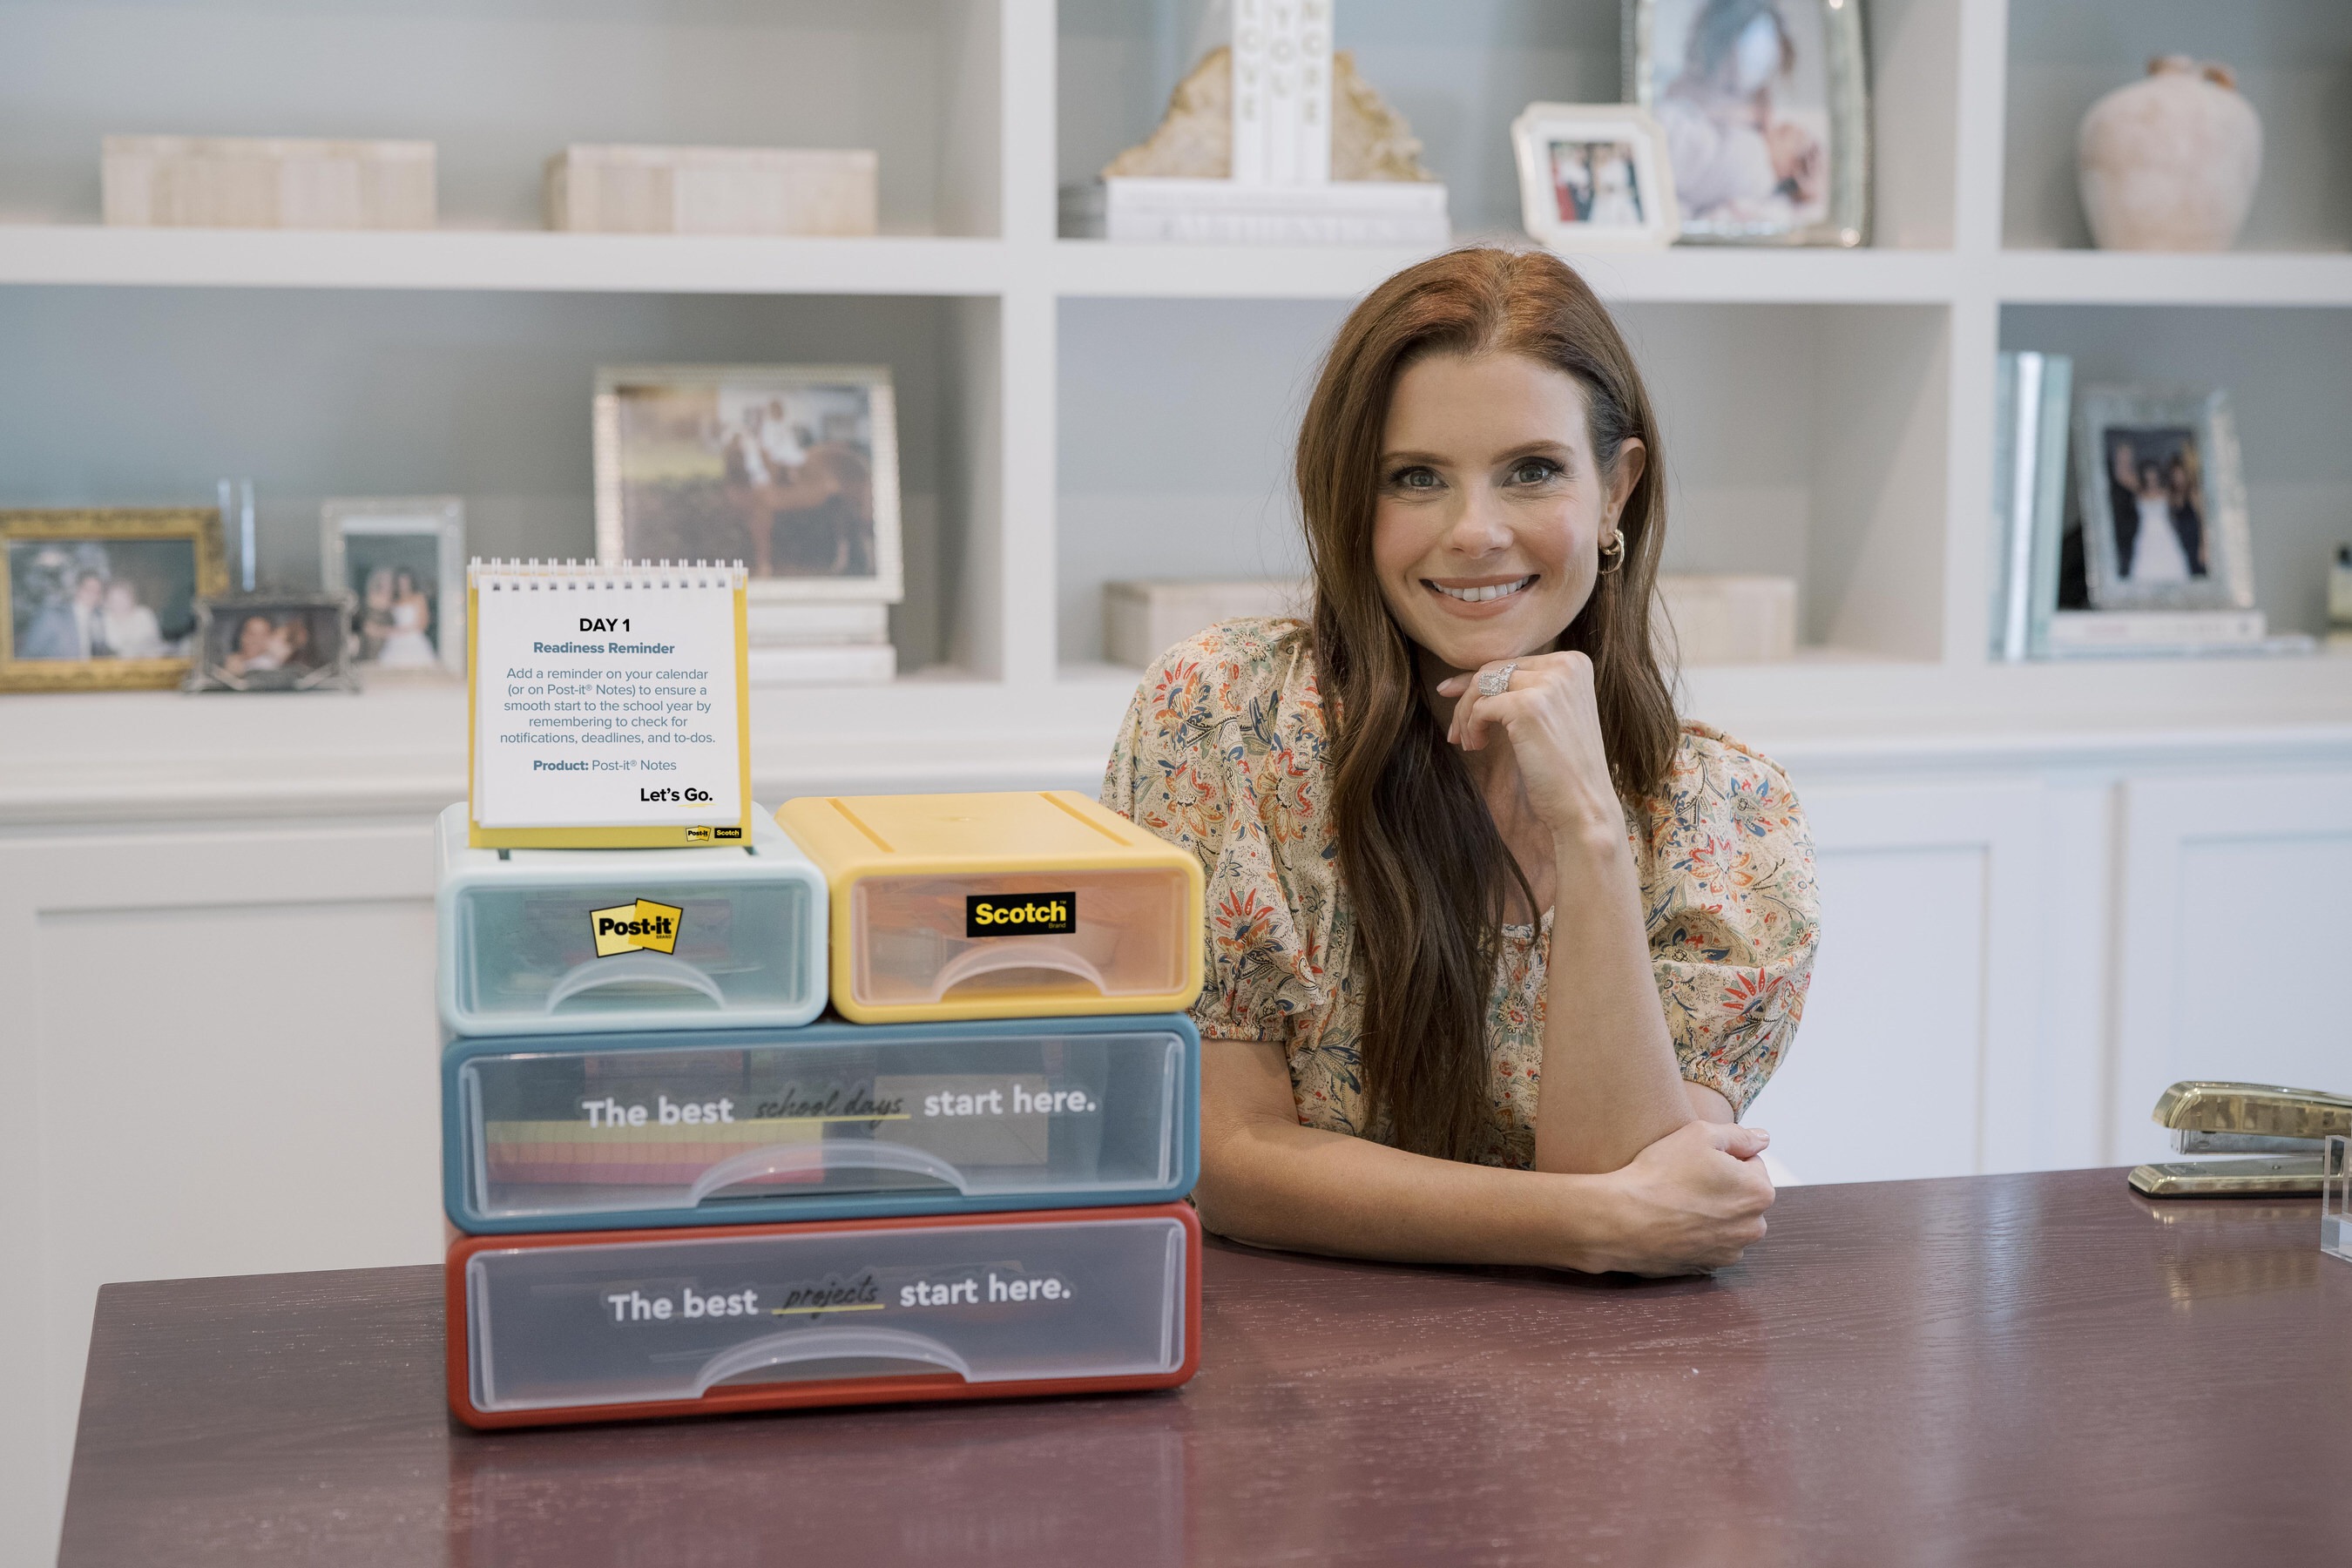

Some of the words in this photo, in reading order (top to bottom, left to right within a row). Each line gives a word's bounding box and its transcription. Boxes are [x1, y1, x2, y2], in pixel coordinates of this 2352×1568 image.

[579, 618, 618, 632] DAY
[622, 618, 630, 632] 1
[533, 641, 605, 654] Readiness
[608, 641, 676, 655] Reminder
[506, 667, 533, 679] Add
[536, 670, 544, 679] a
[547, 667, 604, 679] reminder
[605, 670, 622, 679] on
[625, 670, 653, 683] your
[655, 668, 709, 680] calendar
[508, 683, 525, 698] (or
[527, 686, 544, 695] on
[596, 684, 636, 698] Notes)
[638, 685, 652, 696] to
[654, 686, 697, 696] ensure
[700, 686, 707, 696] a
[504, 700, 551, 712] smooth
[554, 700, 582, 712] start
[584, 700, 597, 712] to
[599, 700, 620, 712] the
[622, 700, 664, 712] school
[666, 702, 694, 714] year
[696, 700, 712, 714] by
[529, 715, 612, 730] remembering
[615, 716, 628, 727] to
[631, 715, 669, 727] check
[671, 715, 689, 727] for
[500, 732, 578, 745] notifications,
[581, 732, 645, 745] deadlines,
[647, 732, 671, 743] and
[673, 732, 716, 743] to-dos.
[533, 760, 590, 772] Product:
[640, 759, 677, 771] Notes
[640, 787, 680, 802] Let’s
[684, 787, 713, 802] Go.
[975, 900, 1066, 925] Scotch
[583, 1098, 647, 1128] The
[659, 1096, 734, 1125] best
[754, 1088, 840, 1119] school
[842, 1088, 904, 1130] days
[924, 1089, 1004, 1117] start
[1013, 1084, 1097, 1114] here.
[608, 1291, 672, 1321] The
[684, 1288, 759, 1318] best
[778, 1274, 878, 1320] projects
[900, 1279, 979, 1308] start
[989, 1273, 1071, 1302] here.
